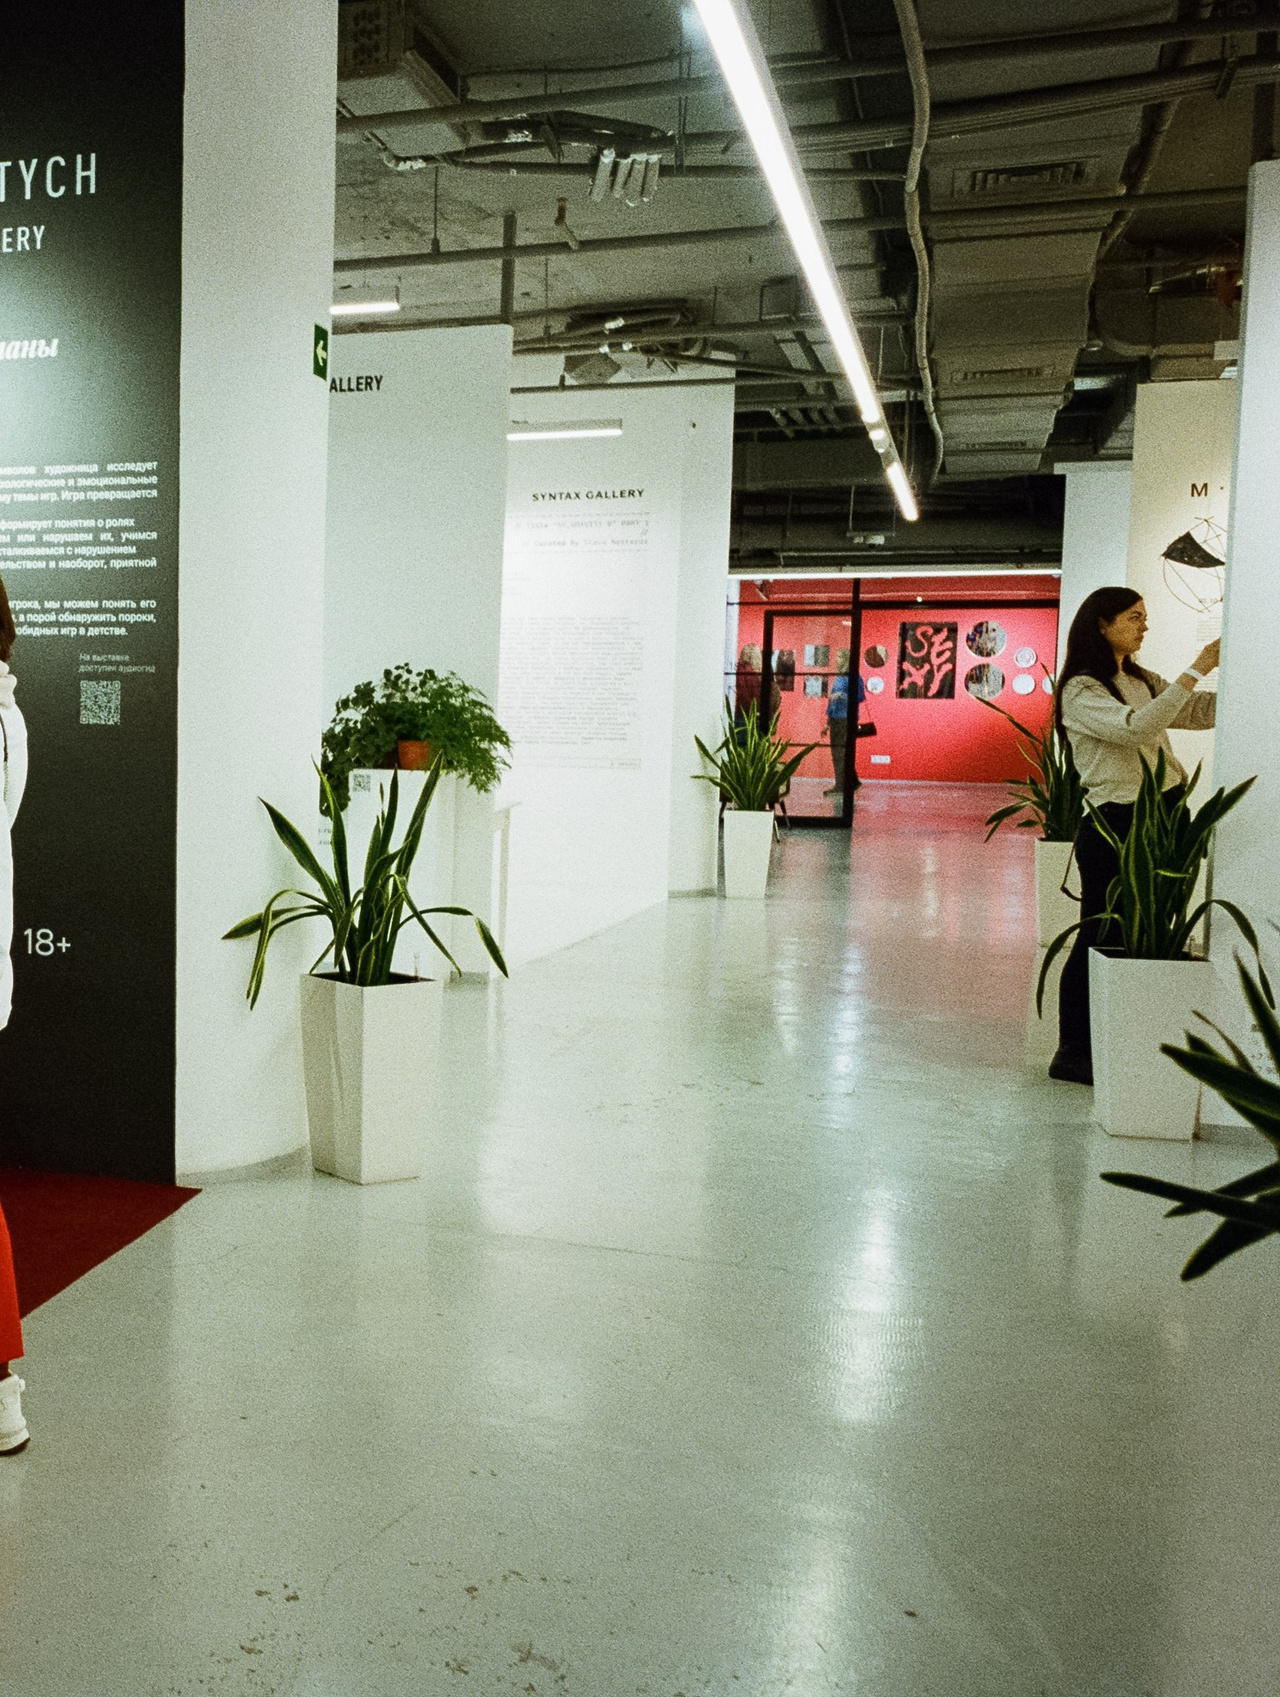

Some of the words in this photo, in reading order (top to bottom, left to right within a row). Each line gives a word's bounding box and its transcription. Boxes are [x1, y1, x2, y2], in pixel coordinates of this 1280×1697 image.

[329, 375, 383, 393] ALLERY
[44, 464, 99, 475] художница
[106, 461, 158, 472] исследует
[68, 479, 75, 487] и
[77, 475, 158, 487] эмоциональные
[12, 493, 39, 502] темы
[61, 490, 85, 502] Игра
[86, 489, 158, 501] превращается
[532, 491, 582, 501] SYNTAX
[586, 488, 645, 500] GALLERY
[1191, 483, 1208, 497] M
[0, 519, 52, 532] формирует
[55, 519, 96, 529] понятия
[97, 520, 104, 528] о
[106, 518, 135, 529] ролях
[17, 534, 36, 543] или
[42, 532, 93, 543] нарушаем
[100, 531, 114, 541] их,
[122, 531, 158, 542] учимся
[67, 547, 73, 555] с
[75, 546, 136, 557] нарушением
[49, 561, 56, 569] и
[59, 558, 108, 570] наоборот,
[110, 556, 157, 569] приятной
[44, 600, 60, 609] мы
[64, 600, 98, 609] можем
[102, 600, 137, 609] понять
[140, 600, 157, 609] его
[19, 613, 25, 622] а
[27, 611, 56, 623] порой
[58, 611, 116, 623] обнаружить
[118, 612, 157, 624] пороки,
[61, 626, 77, 637] игр
[79, 627, 85, 635] в
[87, 626, 128, 637] детстве.
[24, 928, 71, 956] 18+
